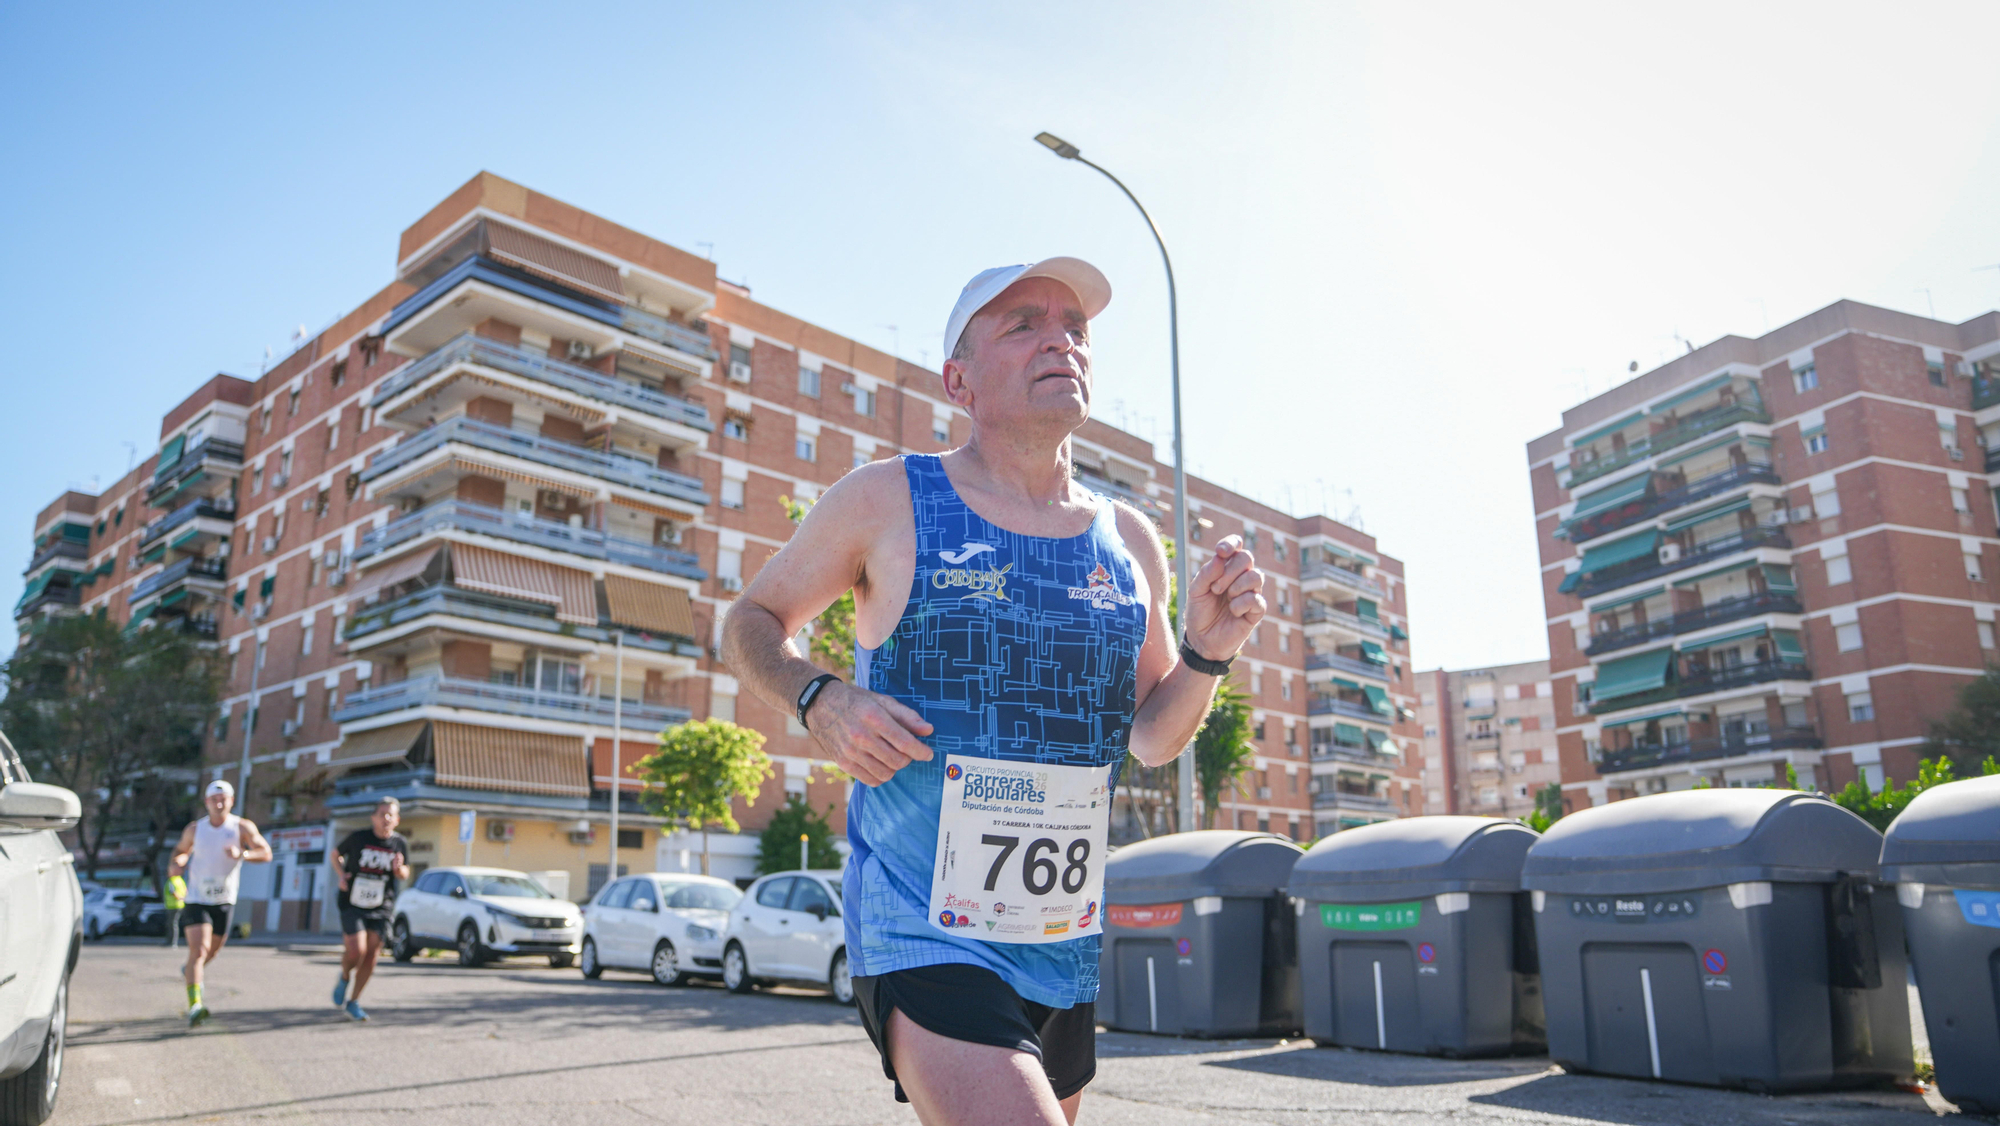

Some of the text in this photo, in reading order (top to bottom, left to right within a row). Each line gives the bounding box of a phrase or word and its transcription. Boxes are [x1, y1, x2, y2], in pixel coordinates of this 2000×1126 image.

[965, 765, 1034, 778] CIRCUITO PROVINCIAL
[1035, 772, 1048, 781] 20
[965, 772, 1034, 790] carreras
[1034, 782, 1047, 790] 26
[963, 783, 1045, 803] populares
[961, 800, 1001, 812] Diputación
[1003, 805, 1012, 813] de
[1014, 805, 1044, 815] Córdoba
[1001, 820, 1031, 828] CARRERA
[981, 833, 1091, 896] 768
[1615, 900, 1644, 911] Resto
